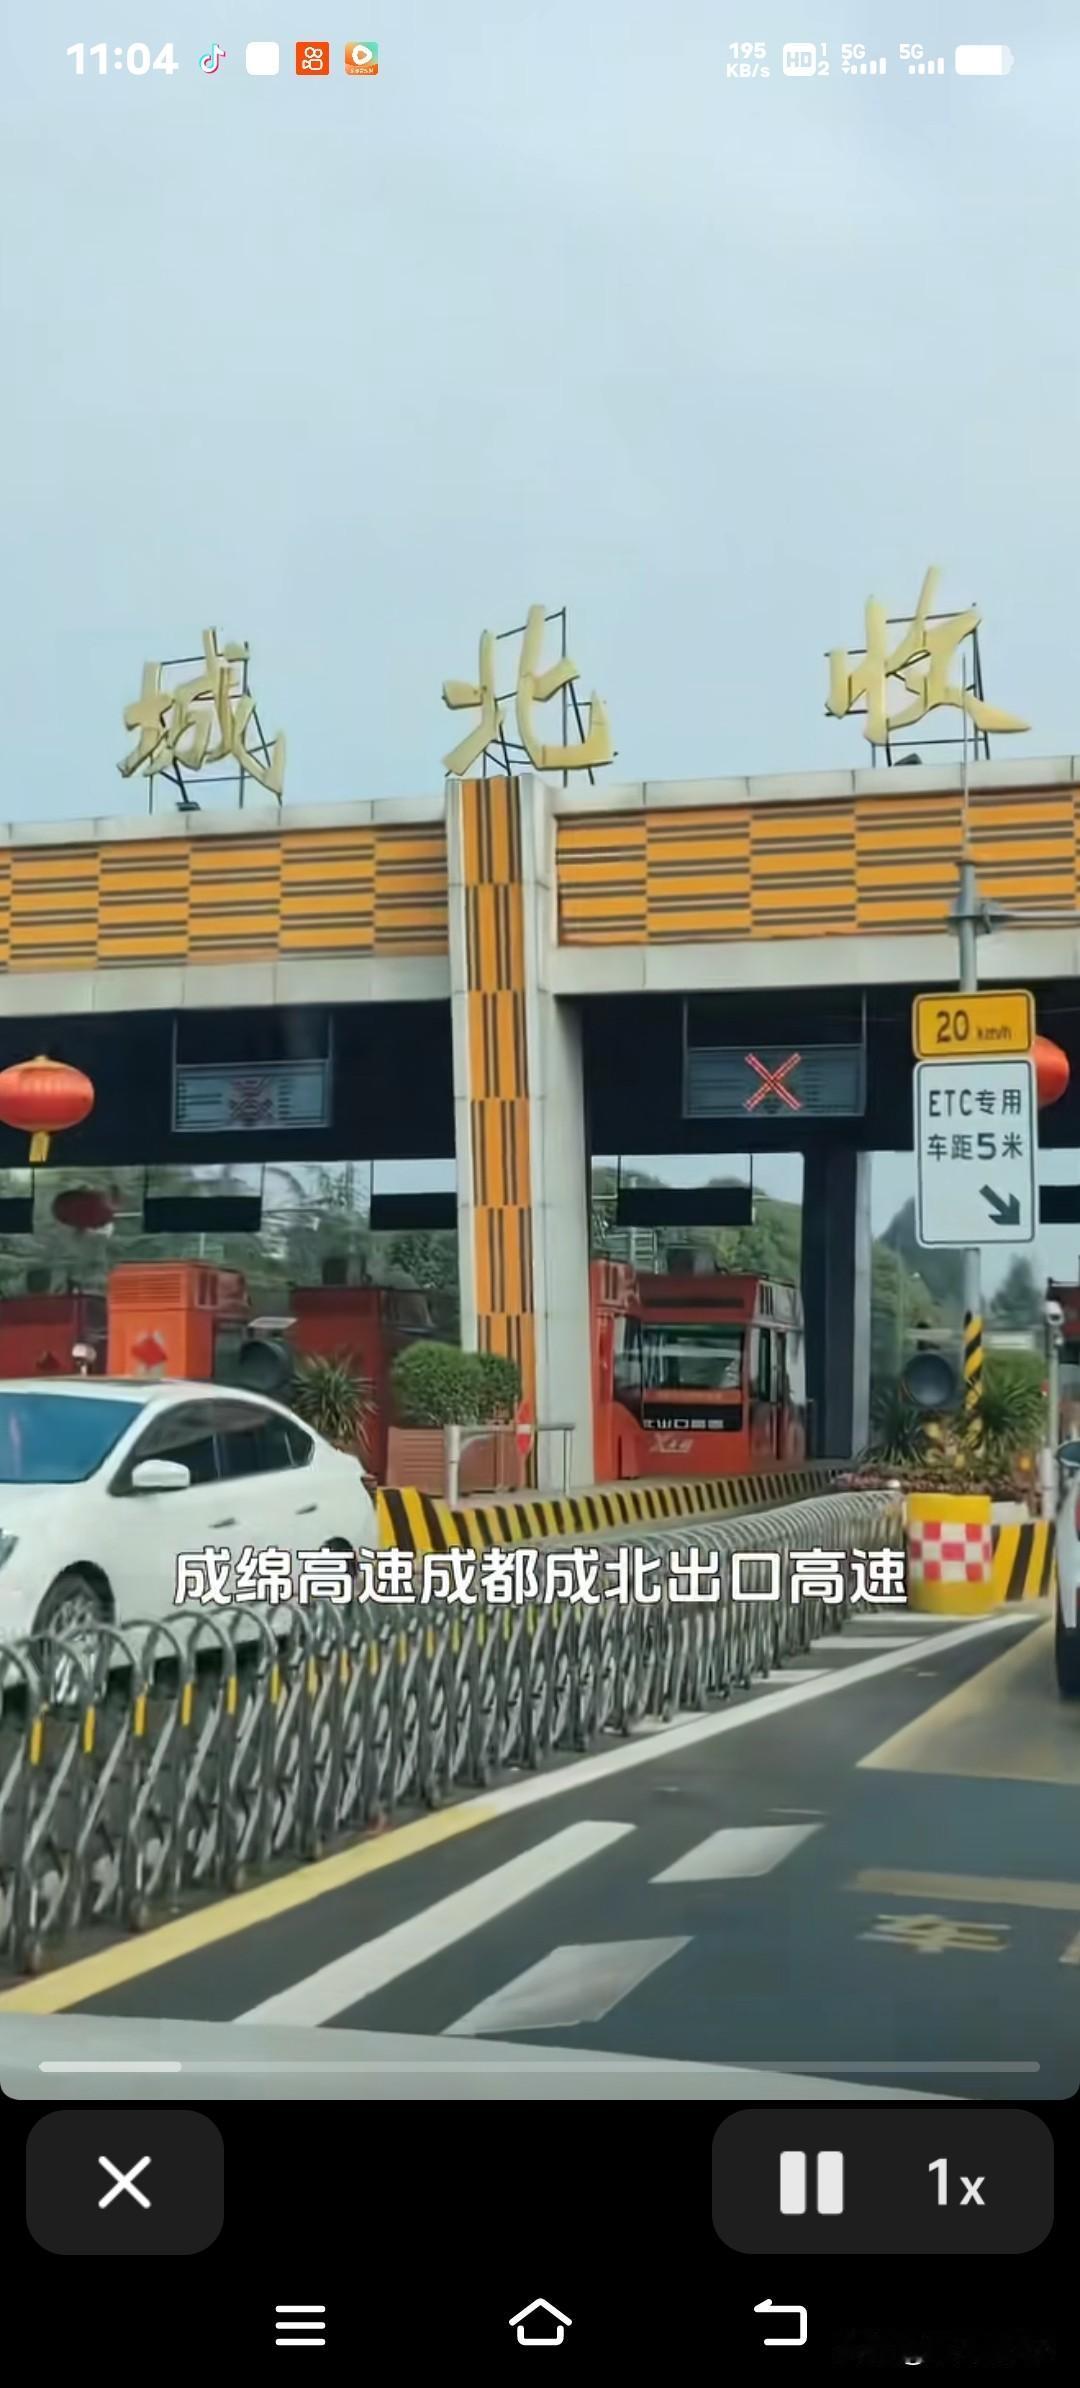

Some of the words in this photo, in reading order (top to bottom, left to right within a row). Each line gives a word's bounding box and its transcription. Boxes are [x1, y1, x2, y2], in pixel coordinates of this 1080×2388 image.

[936, 1009, 970, 1044] 20
[928, 1087, 1023, 1117] ETC专用
[926, 1131, 1025, 1163] 车距5米
